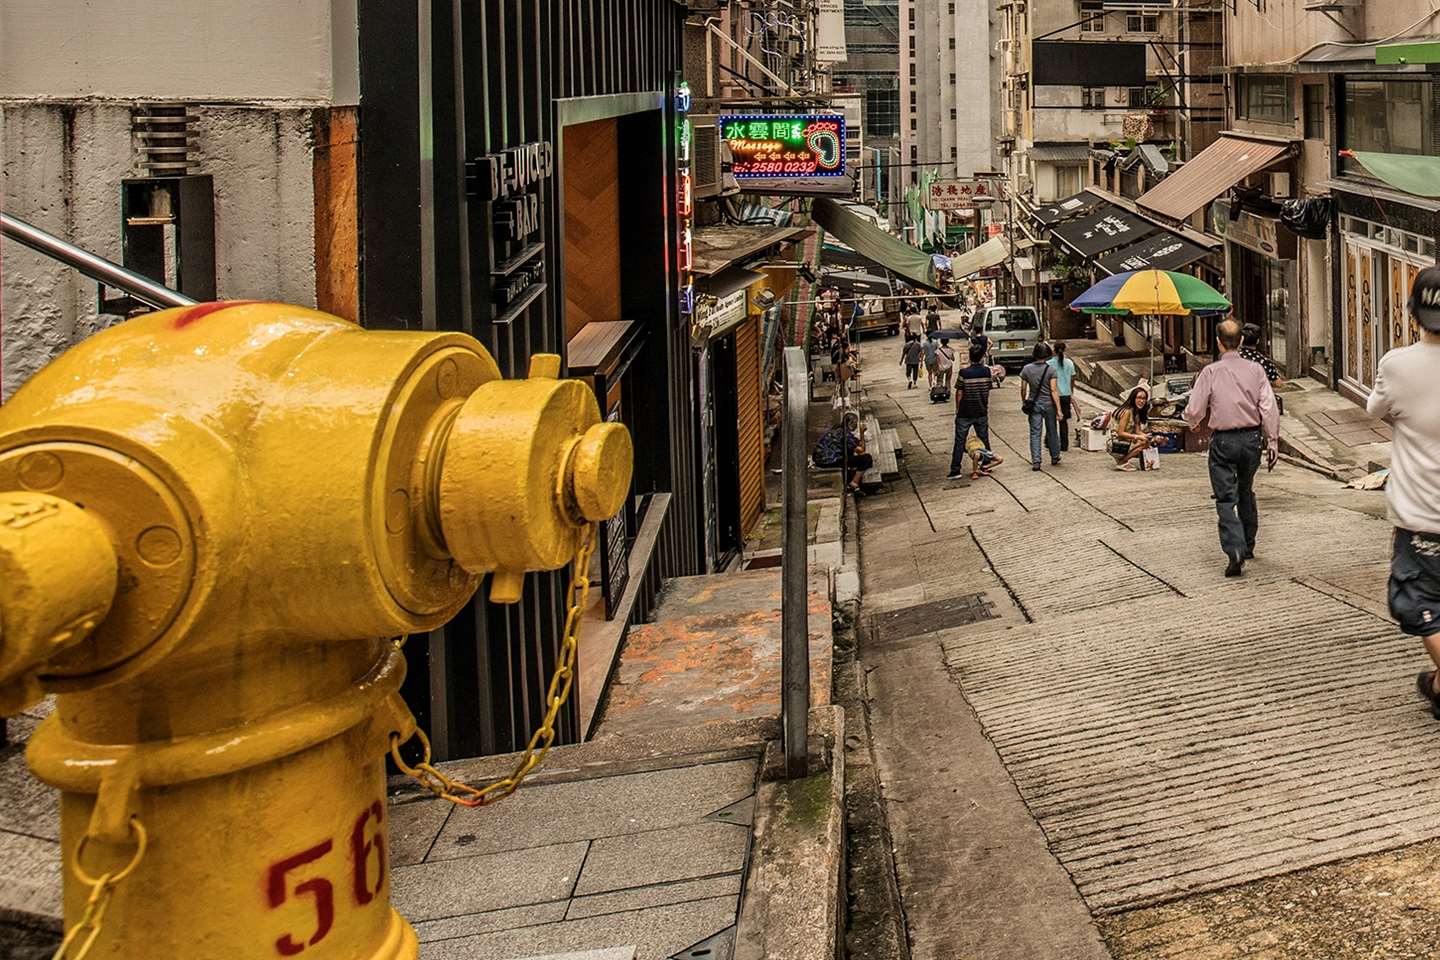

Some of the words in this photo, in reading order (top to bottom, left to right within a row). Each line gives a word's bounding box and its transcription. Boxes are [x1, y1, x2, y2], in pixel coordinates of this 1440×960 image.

[726, 122, 791, 140] 水雲間
[730, 140, 783, 152] Massage
[752, 162, 782, 172] 2580
[785, 162, 815, 172] 0232
[267, 796, 385, 957] 56
